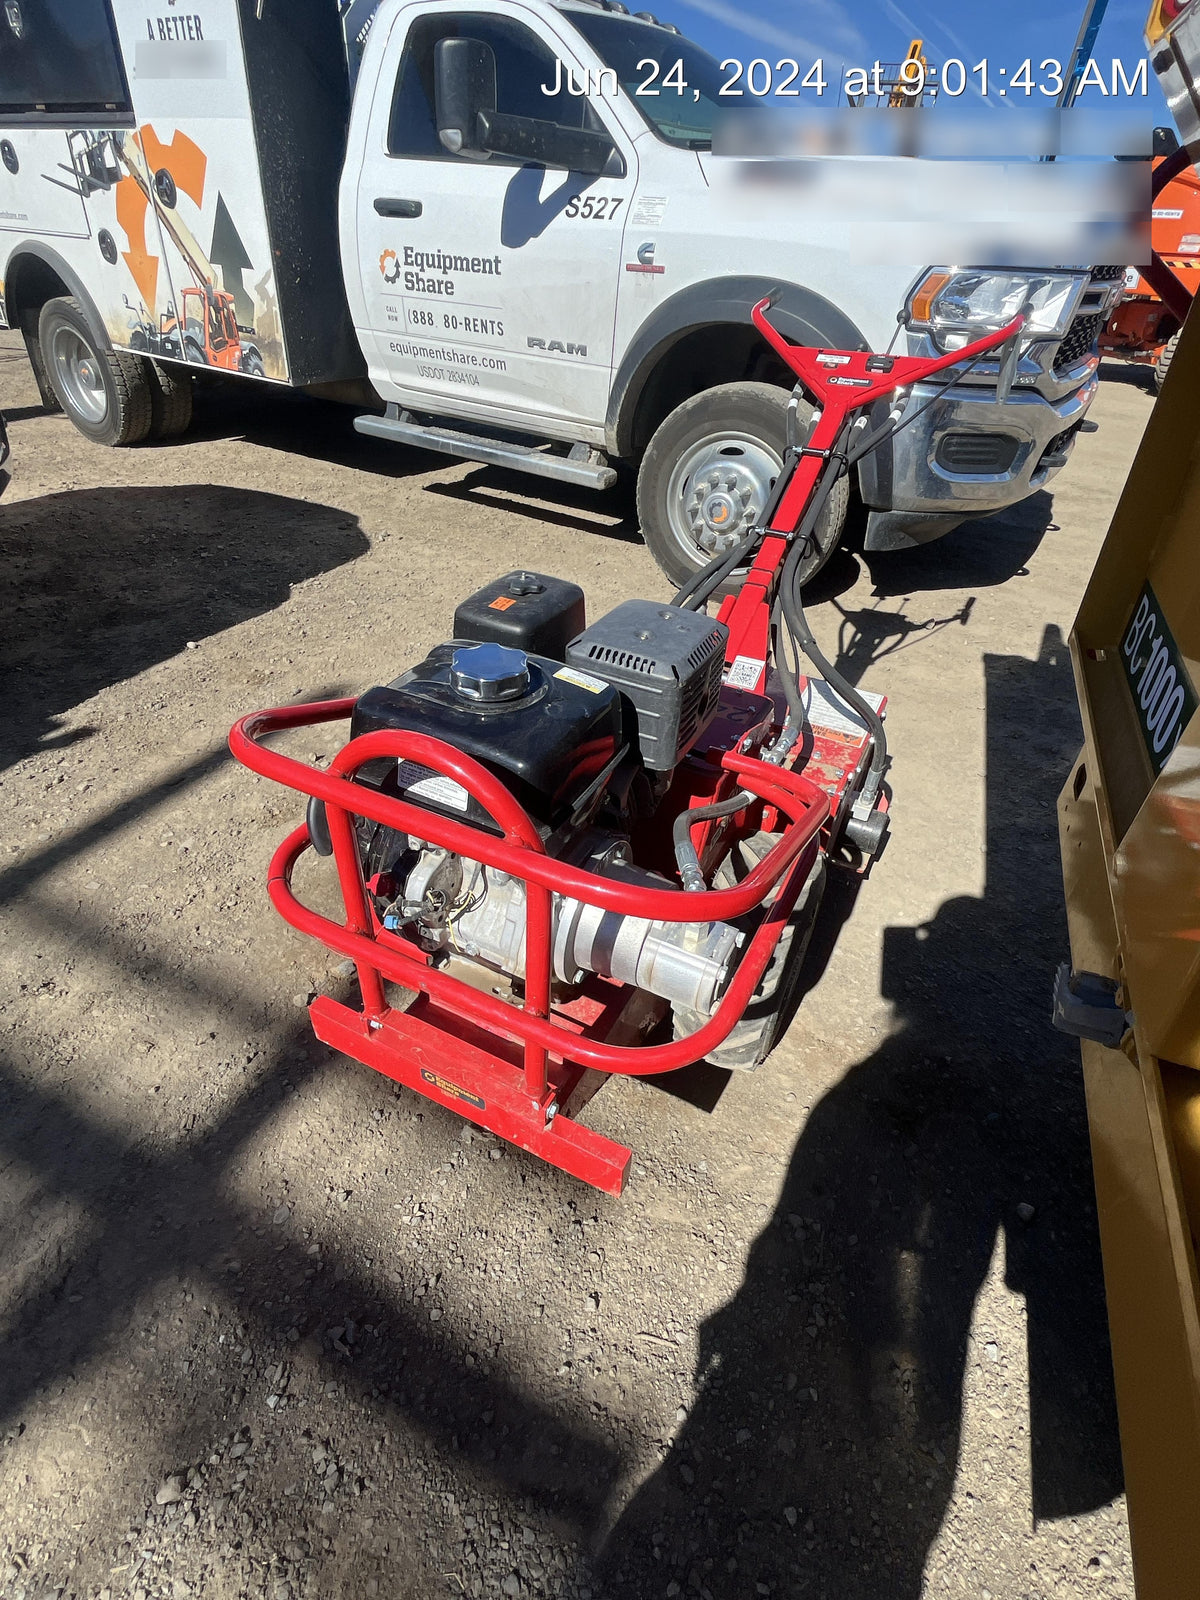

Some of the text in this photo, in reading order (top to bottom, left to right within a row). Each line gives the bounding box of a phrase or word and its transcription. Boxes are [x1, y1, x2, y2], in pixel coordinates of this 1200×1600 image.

[147, 15, 204, 40] A BETTER
[565, 194, 624, 220] S527
[403, 246, 502, 275] Equipment
[404, 271, 455, 295] Share
[443, 314, 504, 336] 80-RENTS
[390, 341, 507, 371] equipmentshare.com
[527, 336, 588, 357] RAM
[417, 365, 446, 381] USDOT
